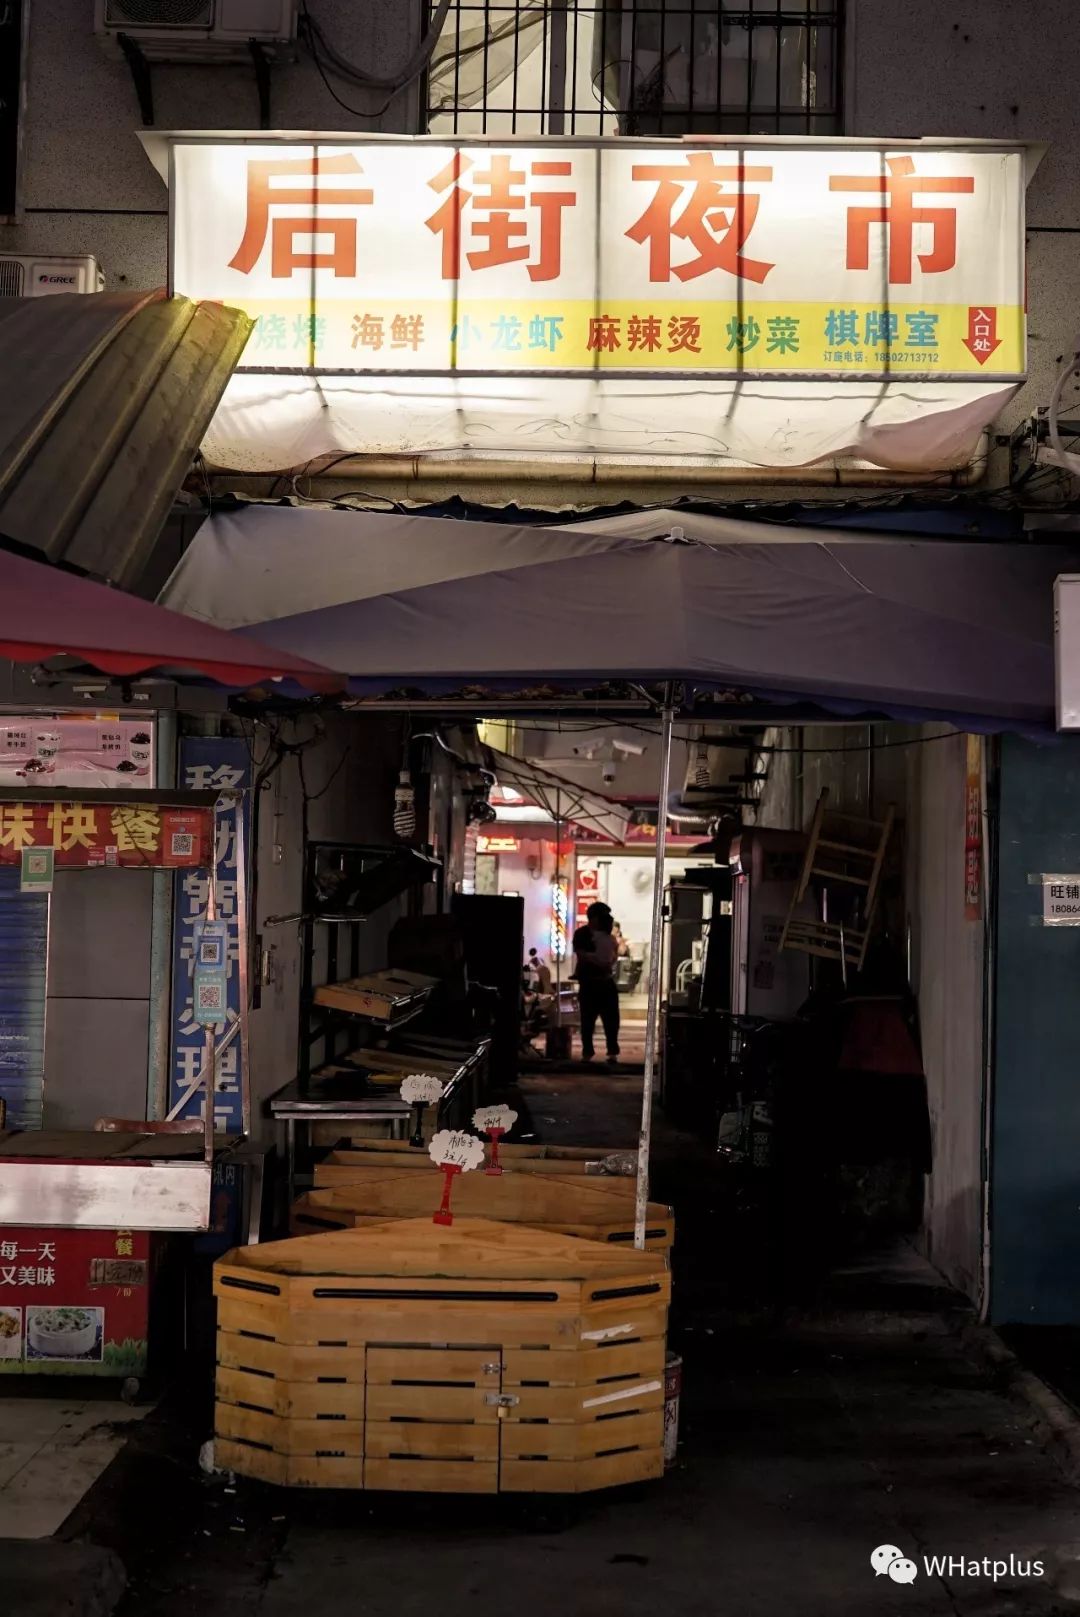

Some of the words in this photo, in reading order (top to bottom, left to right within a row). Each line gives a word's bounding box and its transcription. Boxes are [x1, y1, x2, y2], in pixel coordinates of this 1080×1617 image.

[227, 152, 975, 284] 后街夜市
[49, 276, 75, 284] GREE
[254, 313, 327, 350] 烧烤
[350, 313, 425, 351] 海鲜
[450, 313, 564, 352] 小龙虾
[586, 314, 703, 354] 麻辣烫
[725, 314, 802, 355] 炒菜
[824, 309, 940, 347] 棋牌室
[972, 309, 991, 353] 入口处
[0, 802, 161, 851] 味快餐
[1051, 885, 1079, 899] 旺铺
[0, 1240, 56, 1262] 每一天
[0, 1266, 56, 1287] 又美味
